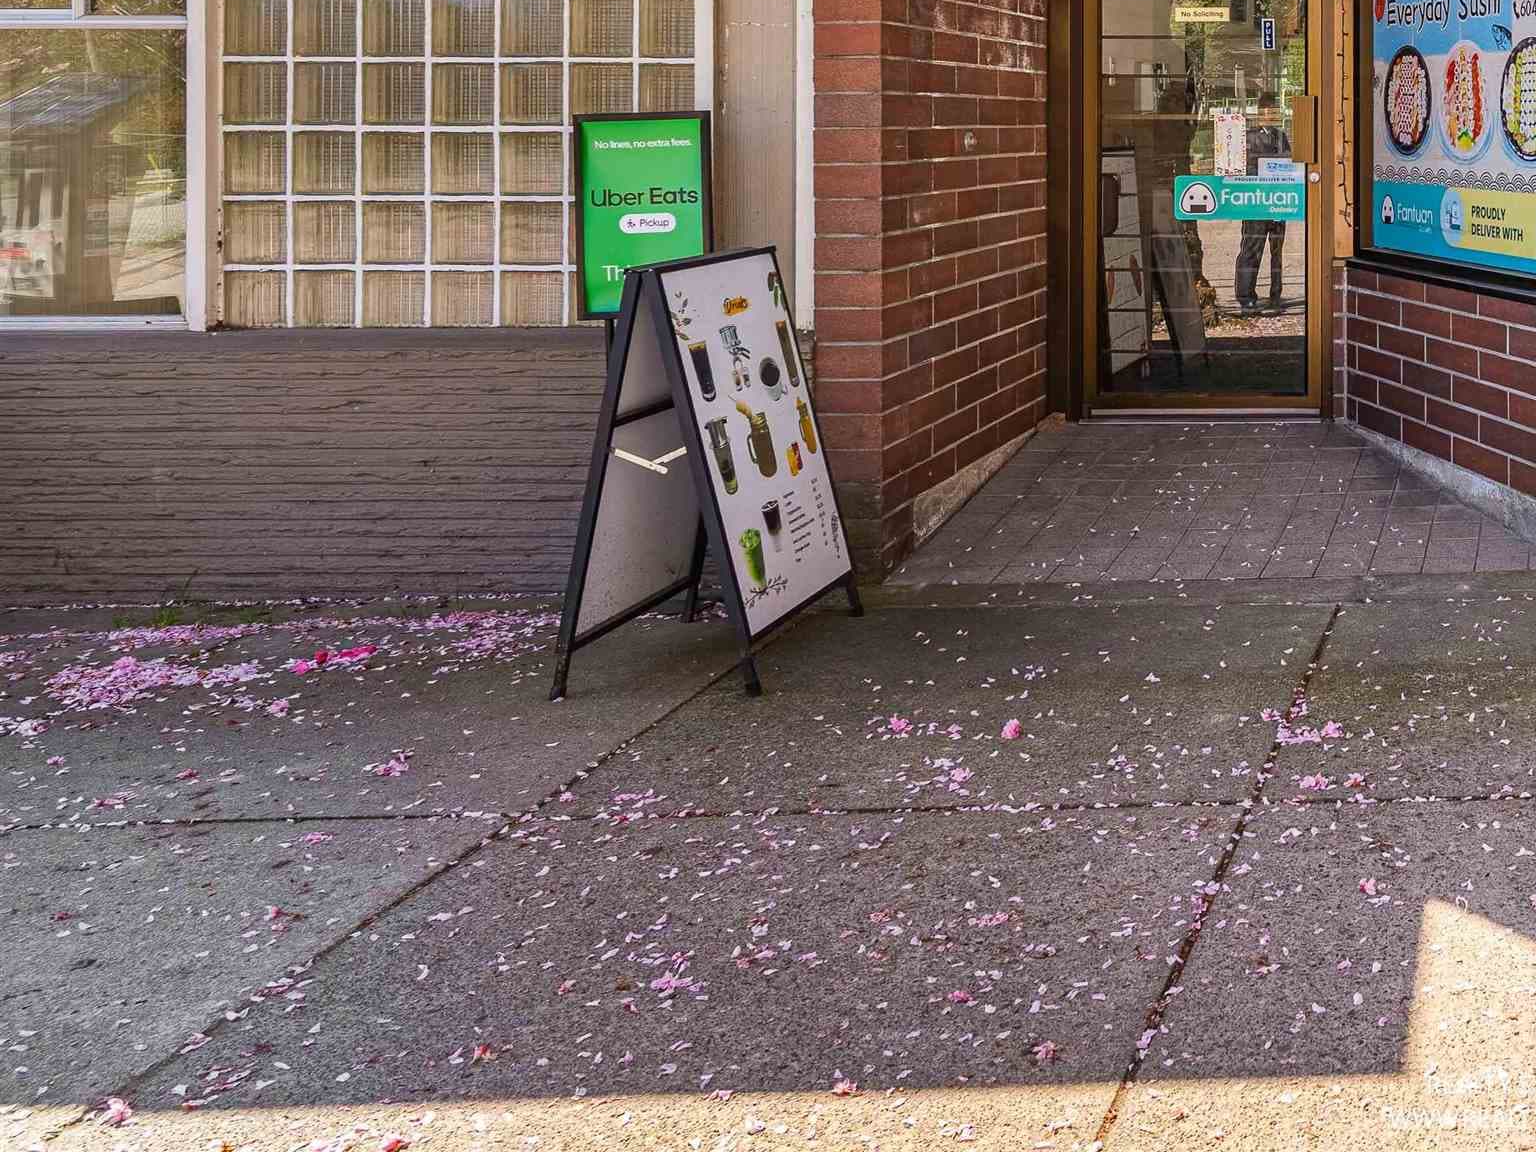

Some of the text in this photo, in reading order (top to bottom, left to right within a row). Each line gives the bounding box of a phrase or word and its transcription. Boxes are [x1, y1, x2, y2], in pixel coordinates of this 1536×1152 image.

[593, 140, 608, 149] No
[591, 187, 700, 207] Uber Eats
[1221, 188, 1298, 205] Fantuan
[1397, 203, 1433, 225] Fantuan
[1471, 205, 1506, 221] PROUDLY
[639, 218, 670, 228] Pickup
[1471, 223, 1524, 242] DELIVER WITH
